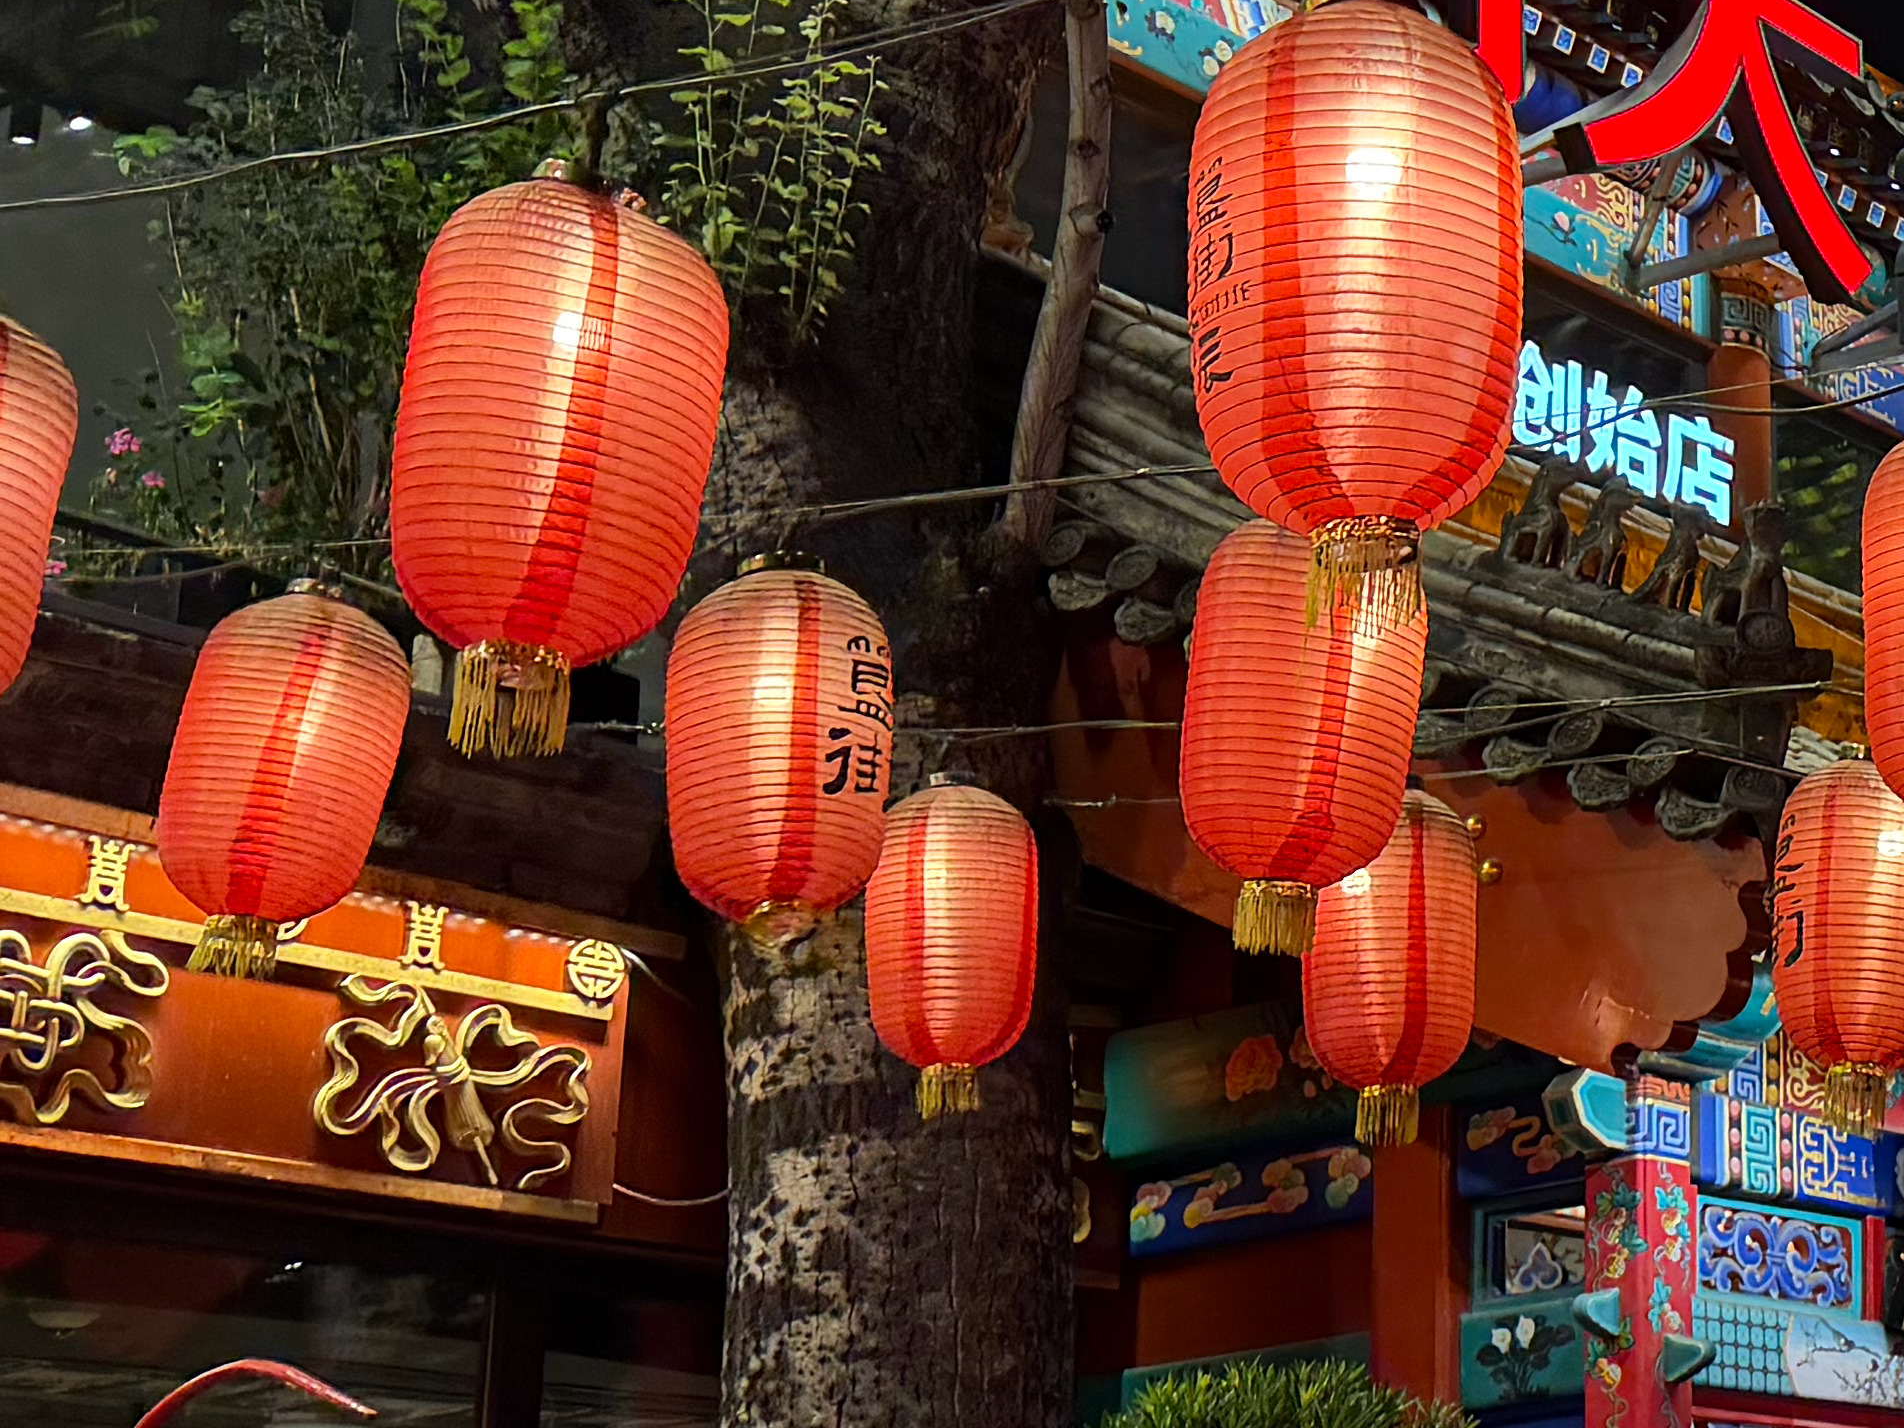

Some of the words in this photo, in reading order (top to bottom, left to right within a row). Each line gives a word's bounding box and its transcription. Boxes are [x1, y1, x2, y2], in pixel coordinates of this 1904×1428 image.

[1511, 338, 1736, 527] 创始店
[820, 634, 894, 795] 簋街
